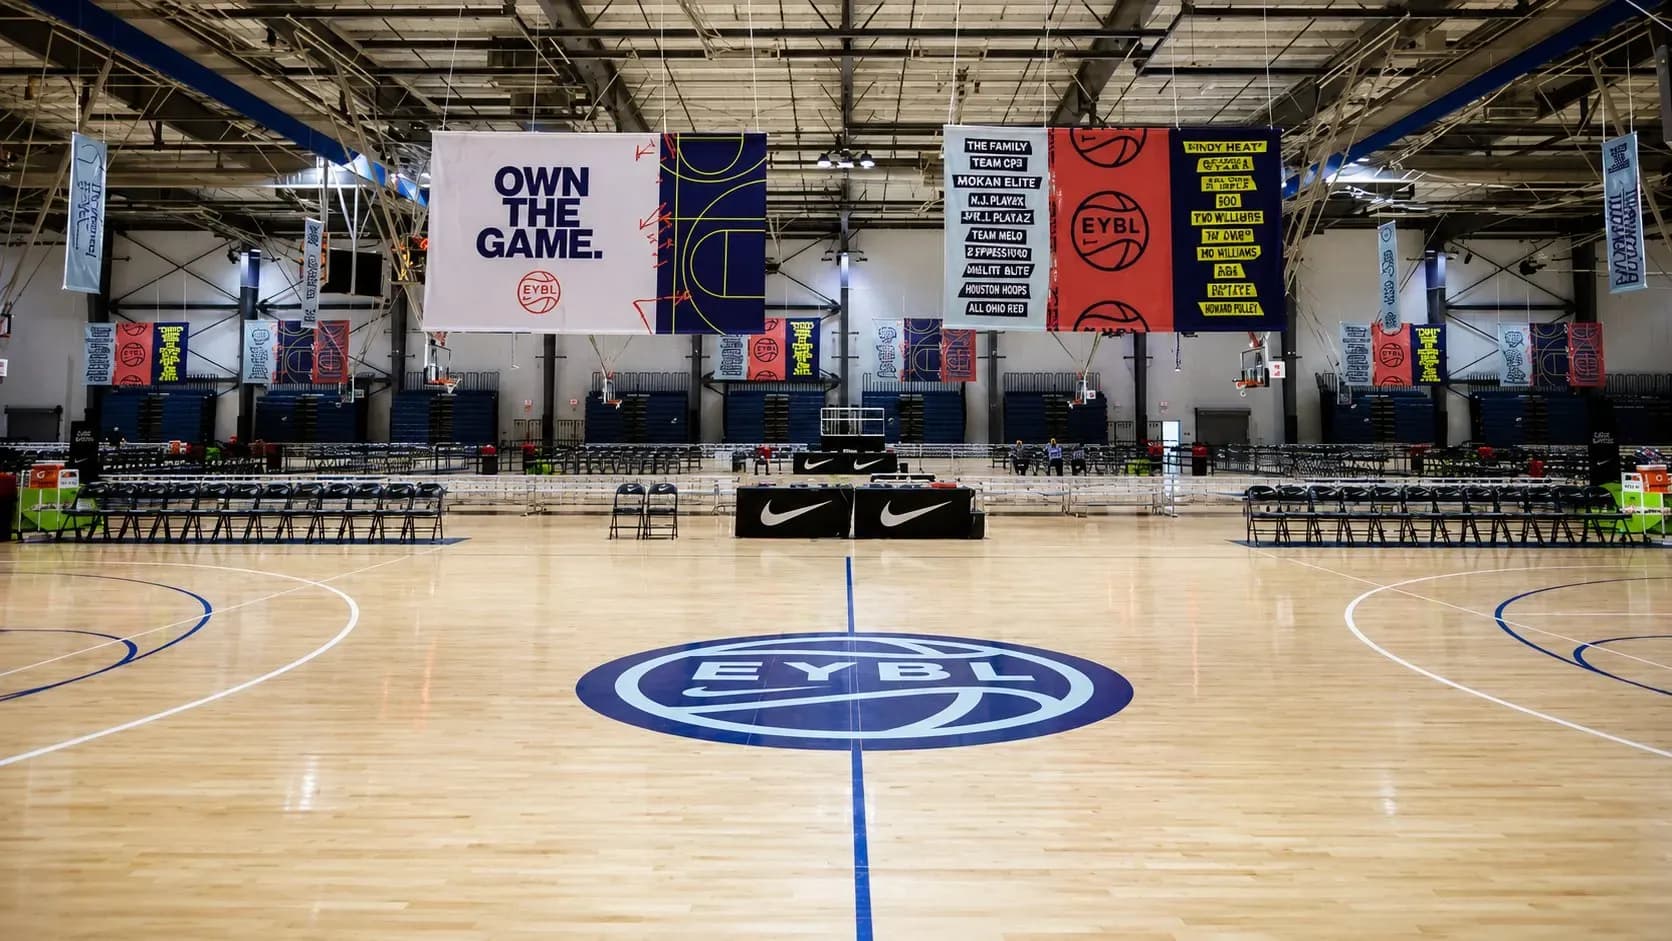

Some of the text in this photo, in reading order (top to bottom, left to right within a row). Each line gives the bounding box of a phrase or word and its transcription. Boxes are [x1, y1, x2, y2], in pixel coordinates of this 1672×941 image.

[967, 141, 1028, 152] THE FAMILY
[972, 158, 1023, 169] TEAM CP3
[494, 166, 590, 197] OWN
[957, 176, 1036, 188] MOKAN ELITE
[502, 198, 581, 228] THE
[1082, 217, 1140, 234] EYBL
[972, 230, 1023, 241] TEAM MELO
[476, 227, 604, 260] GAME.
[523, 285, 558, 295] EYBL
[965, 284, 1027, 295] HOUSTON HOOPS
[968, 303, 984, 313] ALL
[985, 304, 1006, 313] OHIO
[691, 661, 1037, 682] EYBL
